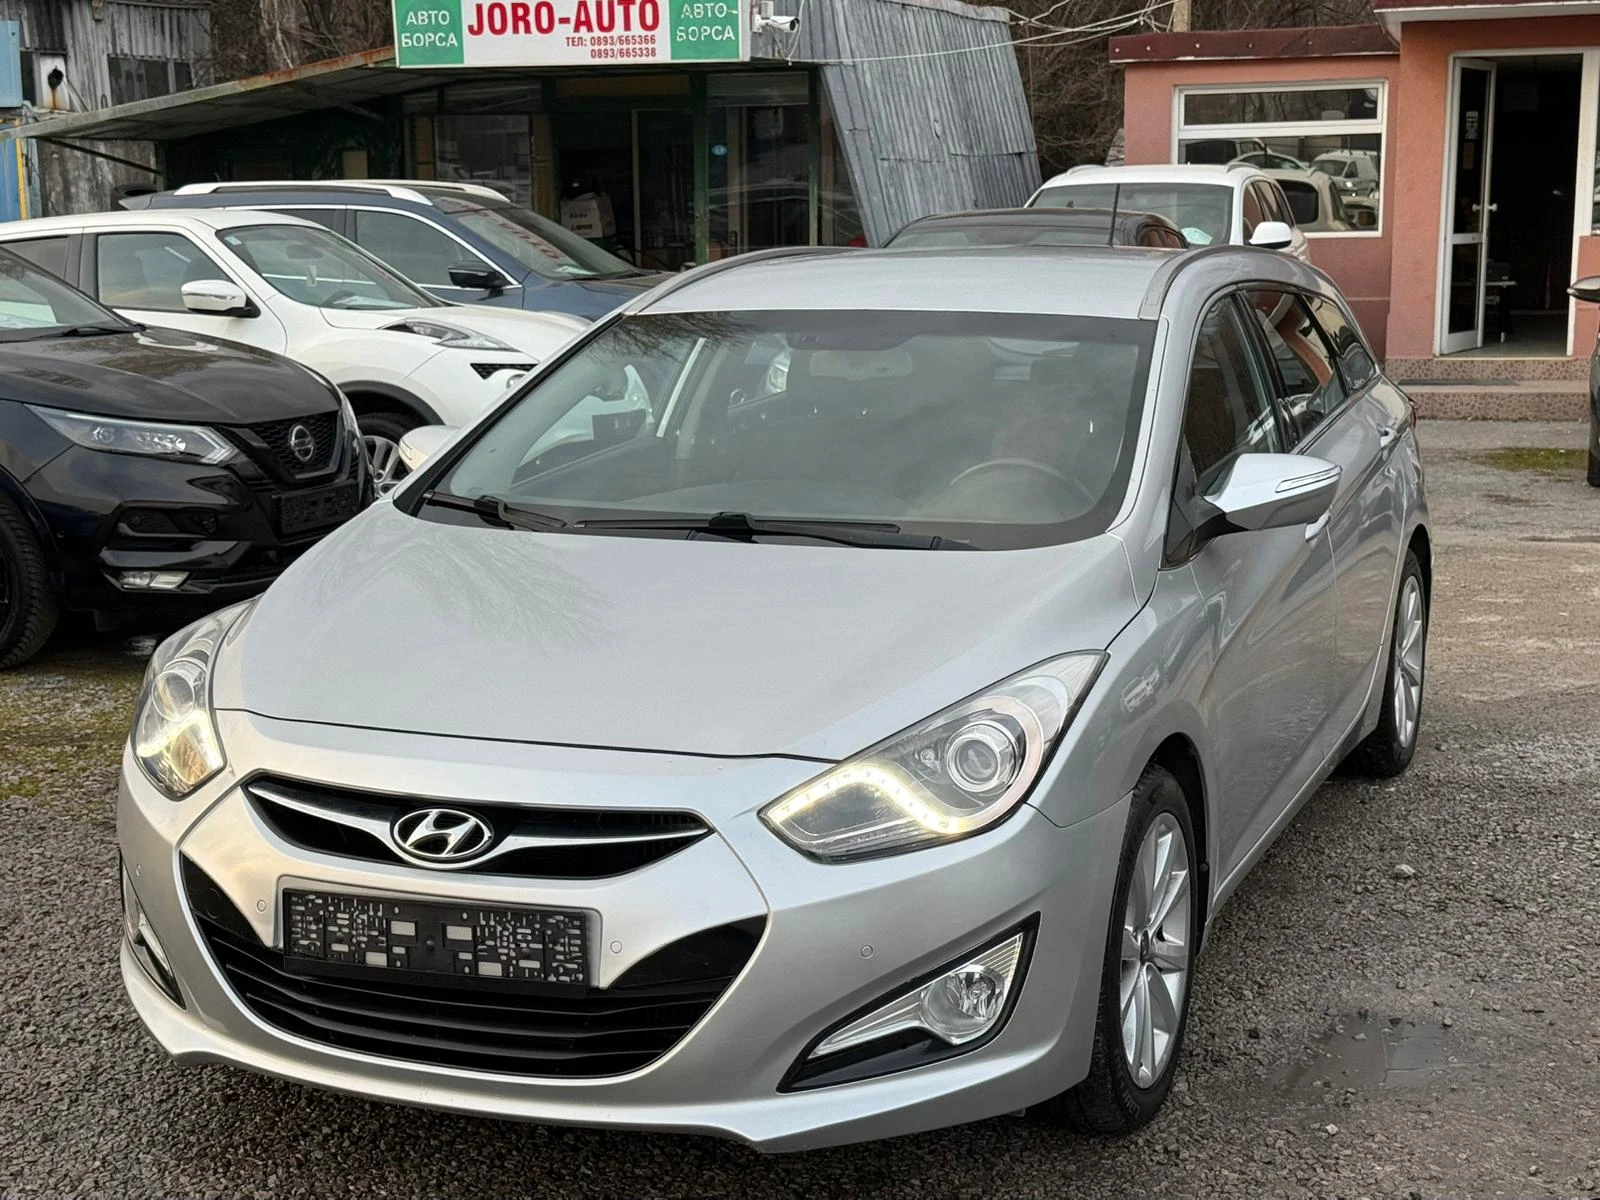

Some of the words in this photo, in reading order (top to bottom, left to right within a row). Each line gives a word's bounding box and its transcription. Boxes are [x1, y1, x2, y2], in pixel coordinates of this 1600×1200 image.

[406, 10, 450, 26] АВТО
[467, 0, 660, 36] JORO-AUTO
[681, 2, 727, 19] АВТО
[401, 32, 458, 48] БОРСА
[565, 36, 588, 47] ТЕЛ:
[589, 34, 657, 47] 0893/665366
[676, 25, 736, 41] БОРСА
[590, 47, 657, 60] 0893/665338
